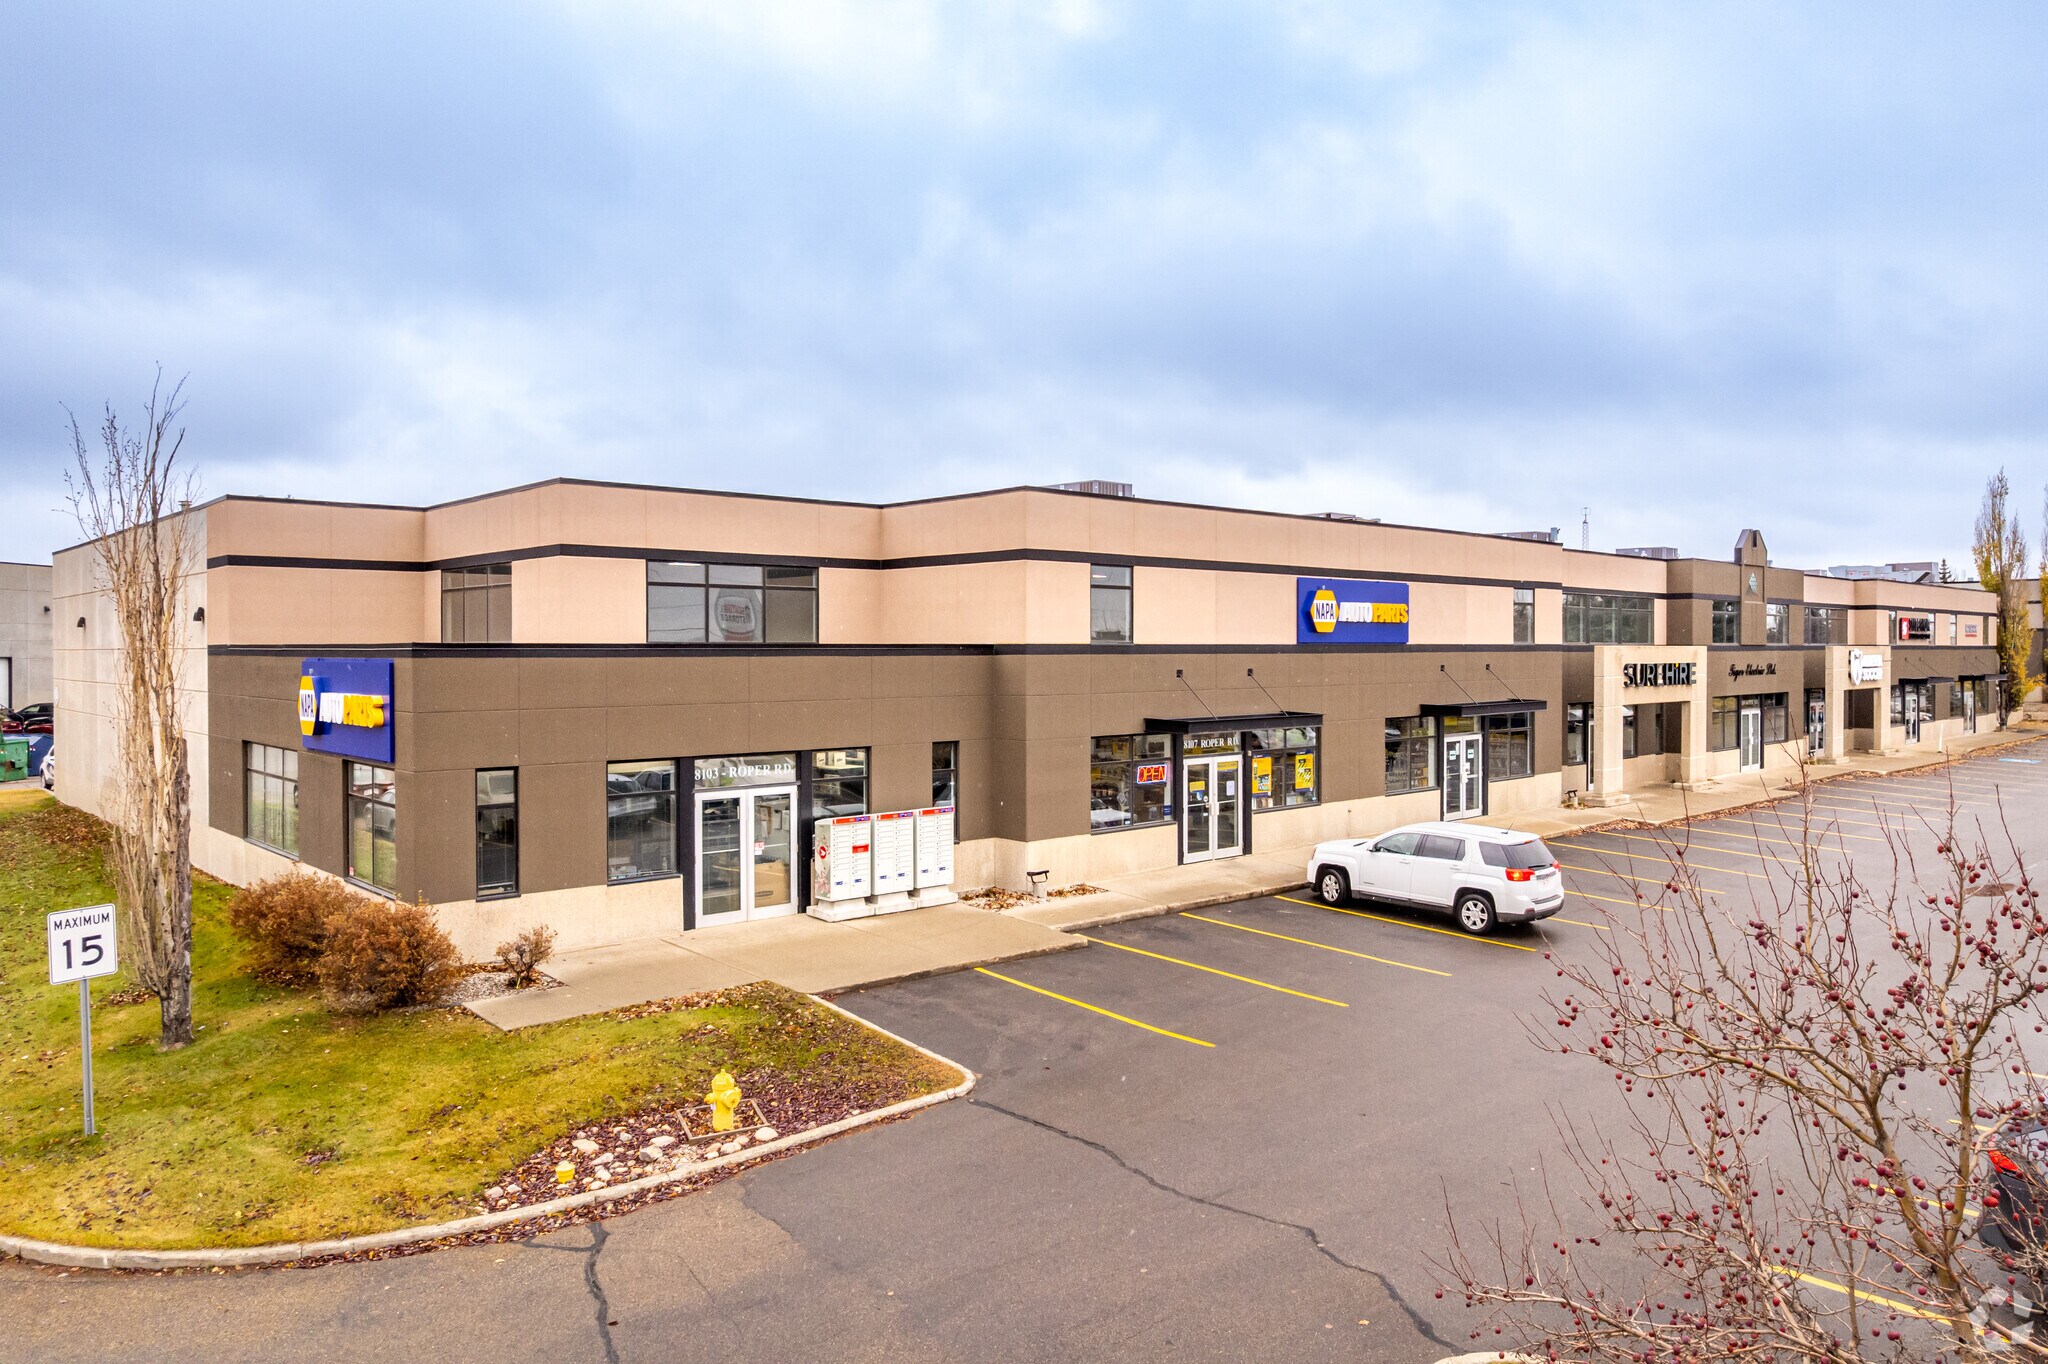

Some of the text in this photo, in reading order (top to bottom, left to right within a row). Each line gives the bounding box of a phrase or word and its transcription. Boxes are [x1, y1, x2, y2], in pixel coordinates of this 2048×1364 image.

[1315, 602, 1335, 620] NAPA
[1372, 603, 1408, 623] PARTS
[1184, 739, 1198, 749] 8107
[1201, 738, 1225, 748] ROPER
[695, 768, 719, 780] 8103
[729, 764, 770, 778] ROPER
[774, 763, 793, 775] RD.
[1138, 765, 1167, 783] OPEN
[54, 912, 110, 931] MAXIMUM
[62, 934, 104, 970] 15
